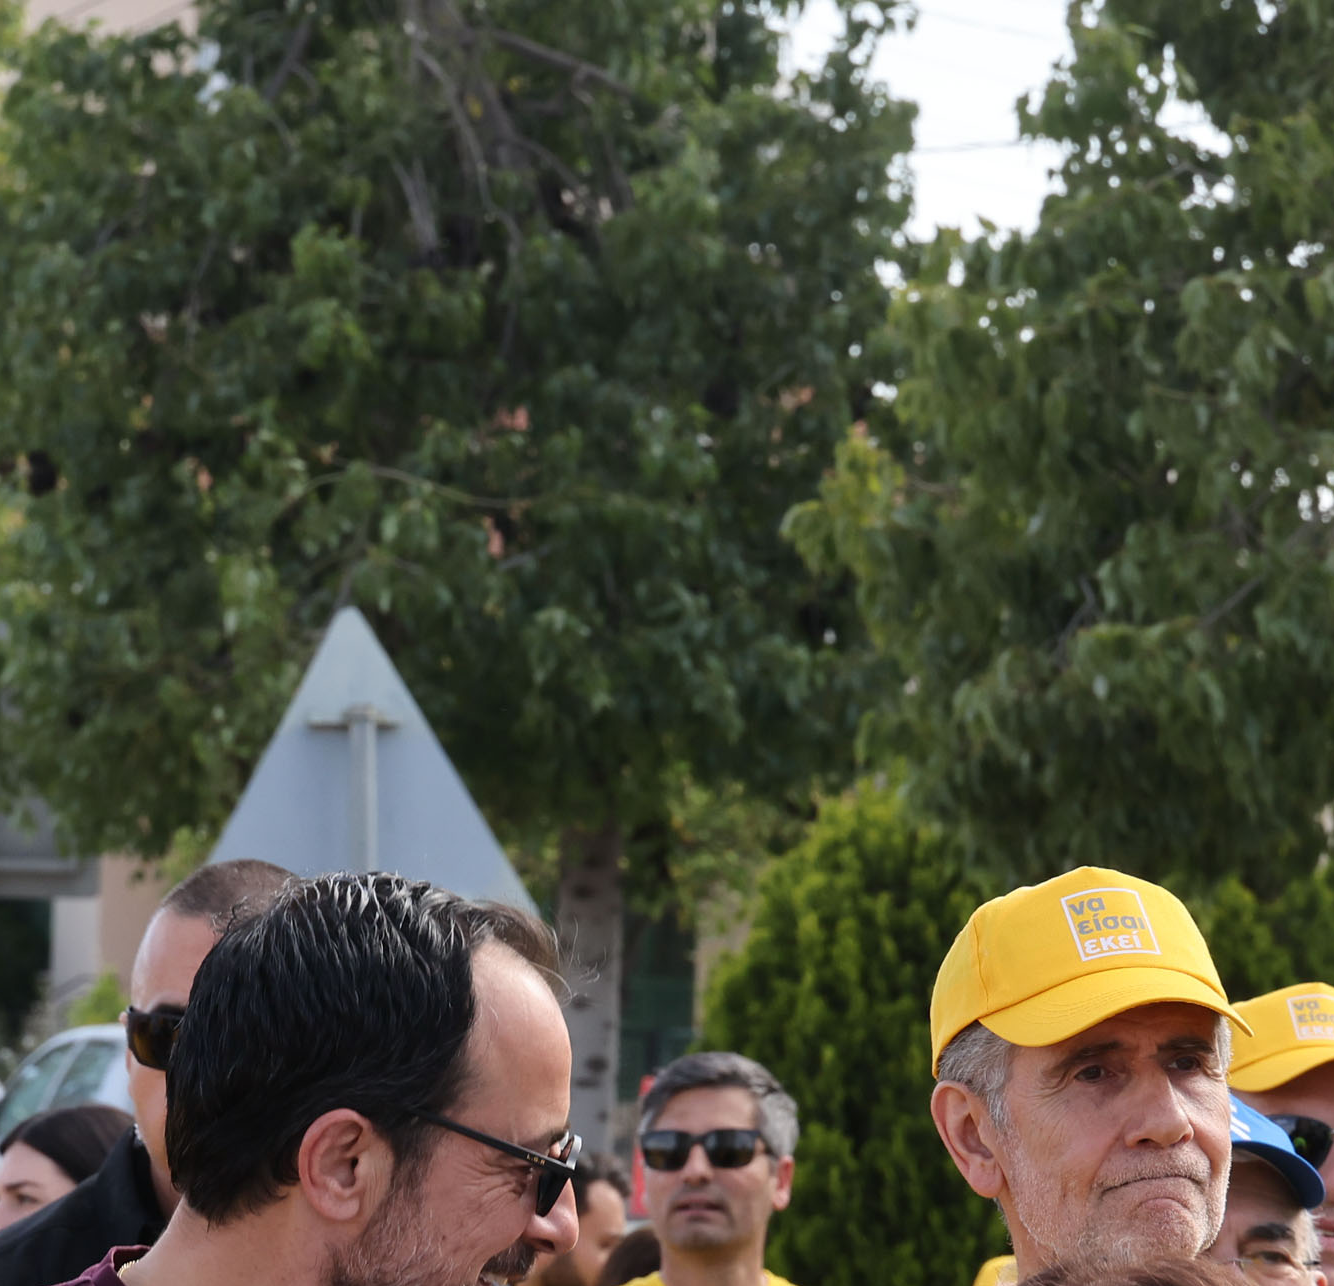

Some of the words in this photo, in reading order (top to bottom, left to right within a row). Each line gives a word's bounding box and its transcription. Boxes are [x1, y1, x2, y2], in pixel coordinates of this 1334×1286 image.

[1069, 898, 1105, 916] να
[1078, 913, 1146, 934] είσαι
[1084, 931, 1142, 954] εκεί
